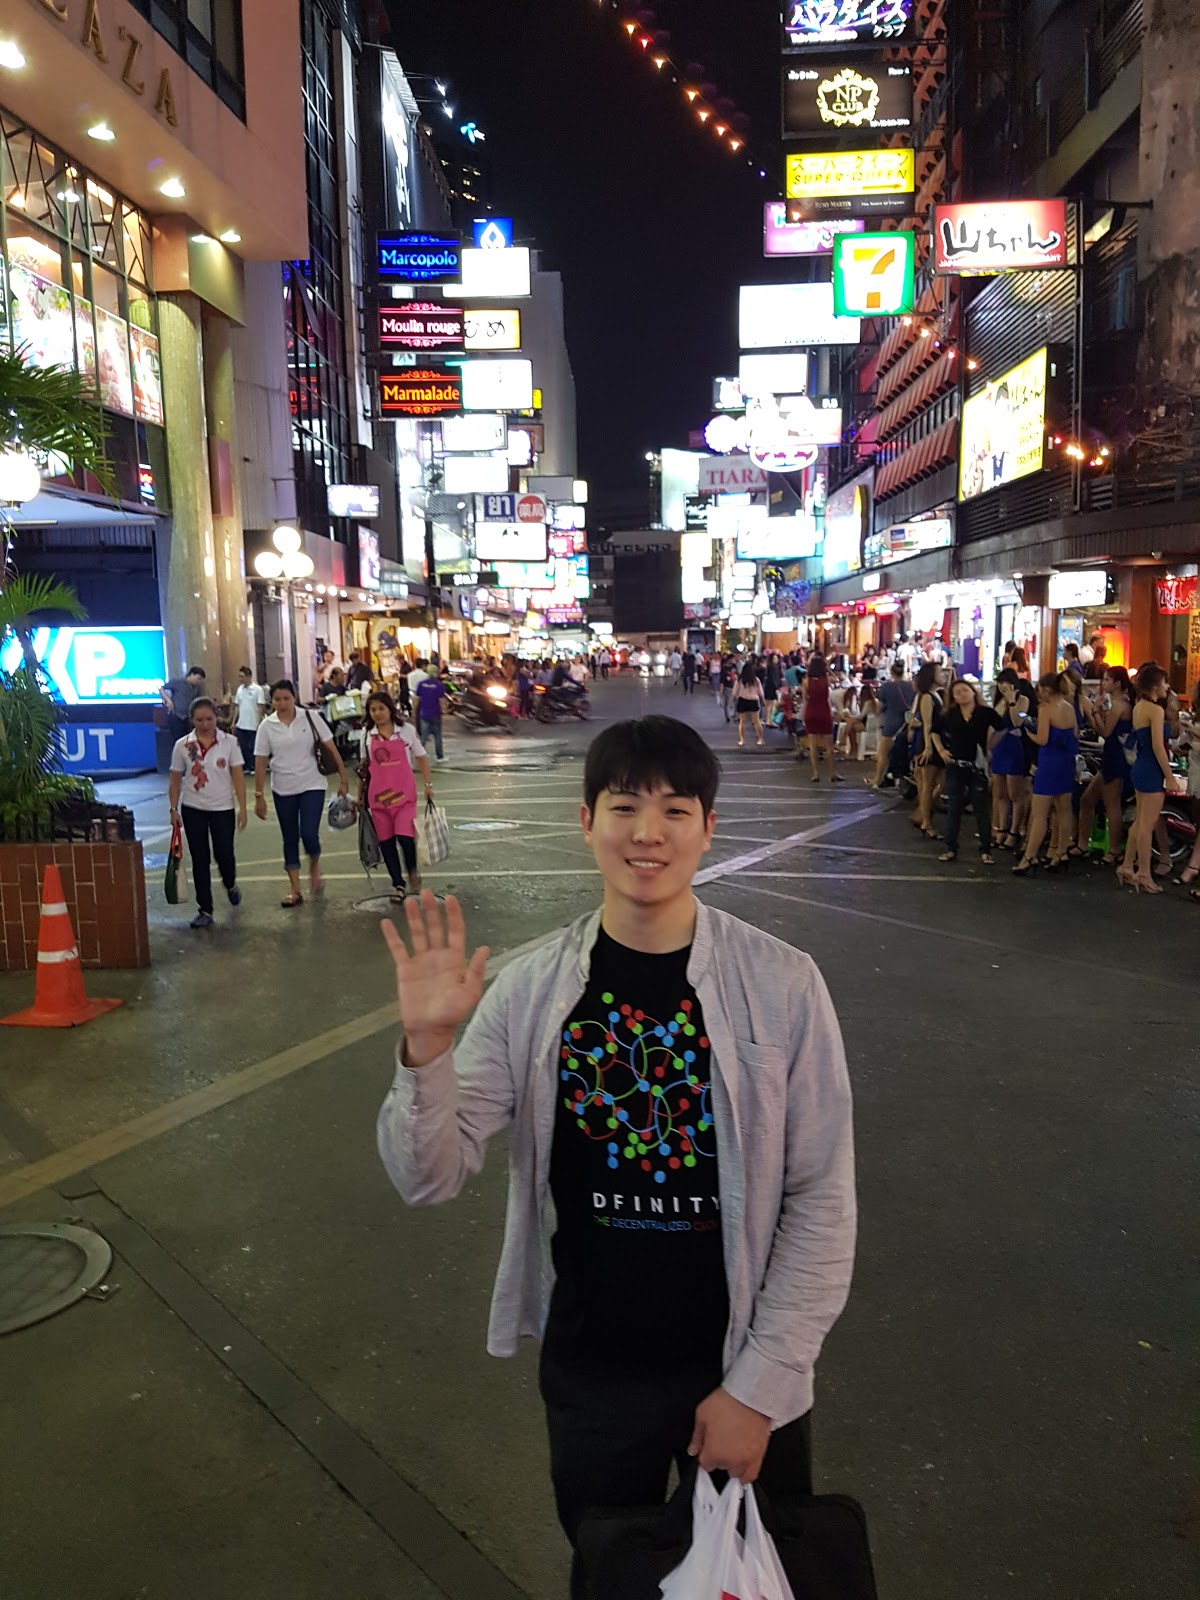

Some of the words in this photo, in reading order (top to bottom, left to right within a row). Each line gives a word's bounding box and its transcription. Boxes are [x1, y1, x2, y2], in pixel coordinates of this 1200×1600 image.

[836, 86, 862, 102] NP
[832, 101, 863, 112] CLUB
[382, 250, 457, 267] Marcopolo
[382, 319, 424, 333] Moulin
[426, 320, 460, 335] rouge
[384, 385, 460, 401] Marmalade
[706, 468, 768, 485] TIARA
